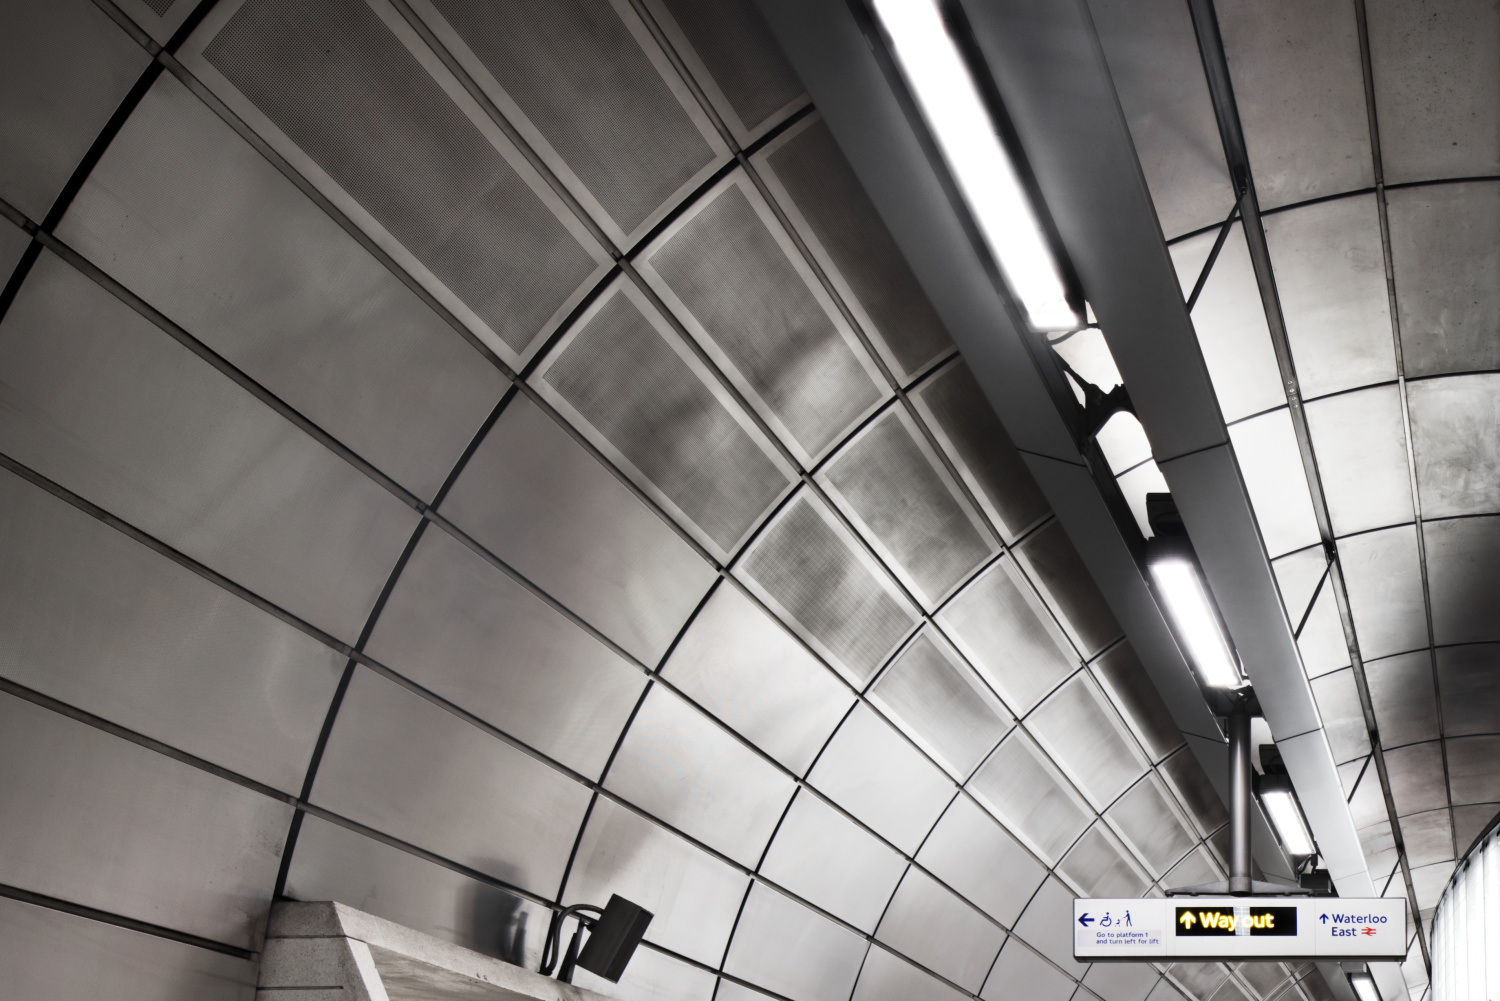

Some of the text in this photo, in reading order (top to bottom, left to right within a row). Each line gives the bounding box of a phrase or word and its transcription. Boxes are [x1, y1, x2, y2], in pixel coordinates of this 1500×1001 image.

[1199, 911, 1275, 932] Way out
[1331, 913, 1388, 924] Waterloo
[1116, 931, 1144, 939] platform
[1331, 926, 1357, 936] East
